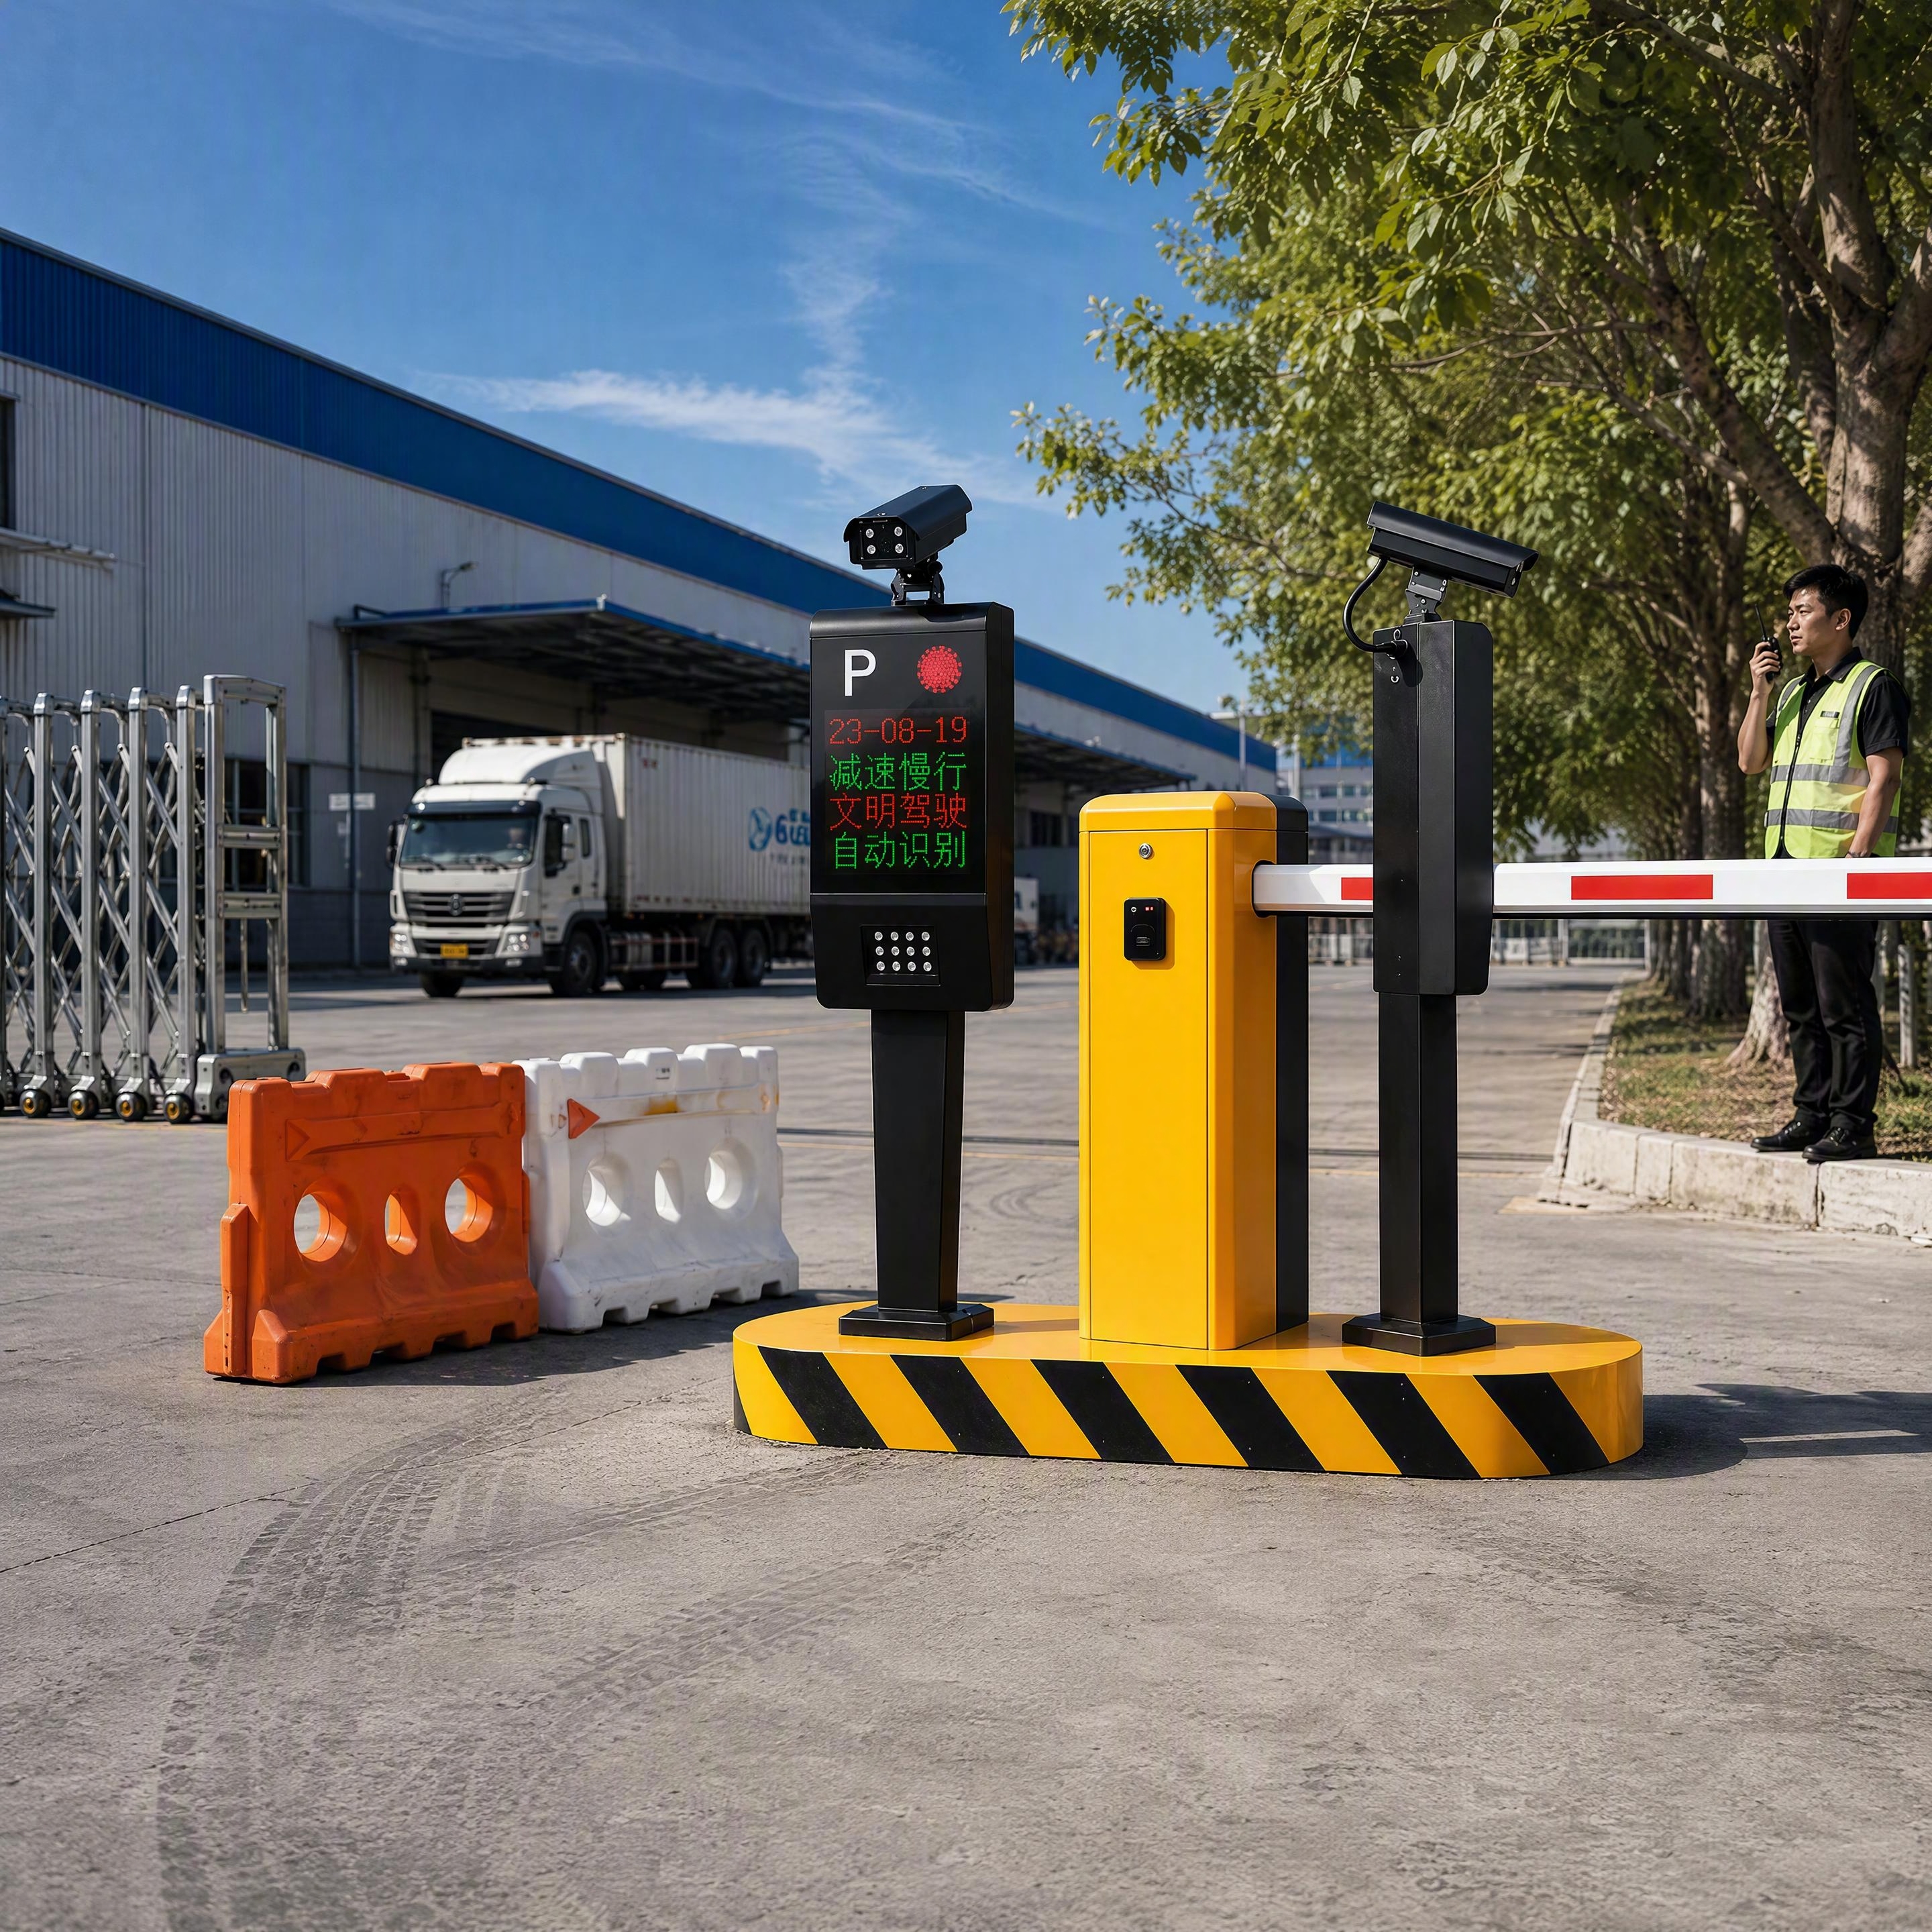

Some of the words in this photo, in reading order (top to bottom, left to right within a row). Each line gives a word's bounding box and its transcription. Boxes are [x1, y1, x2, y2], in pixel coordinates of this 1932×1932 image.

[845, 649, 877, 696] P
[829, 716, 967, 745] 23-08-19
[830, 751, 967, 791] 减速慢行
[829, 792, 967, 830] 文明驾驶
[834, 831, 966, 869] 自动识别
